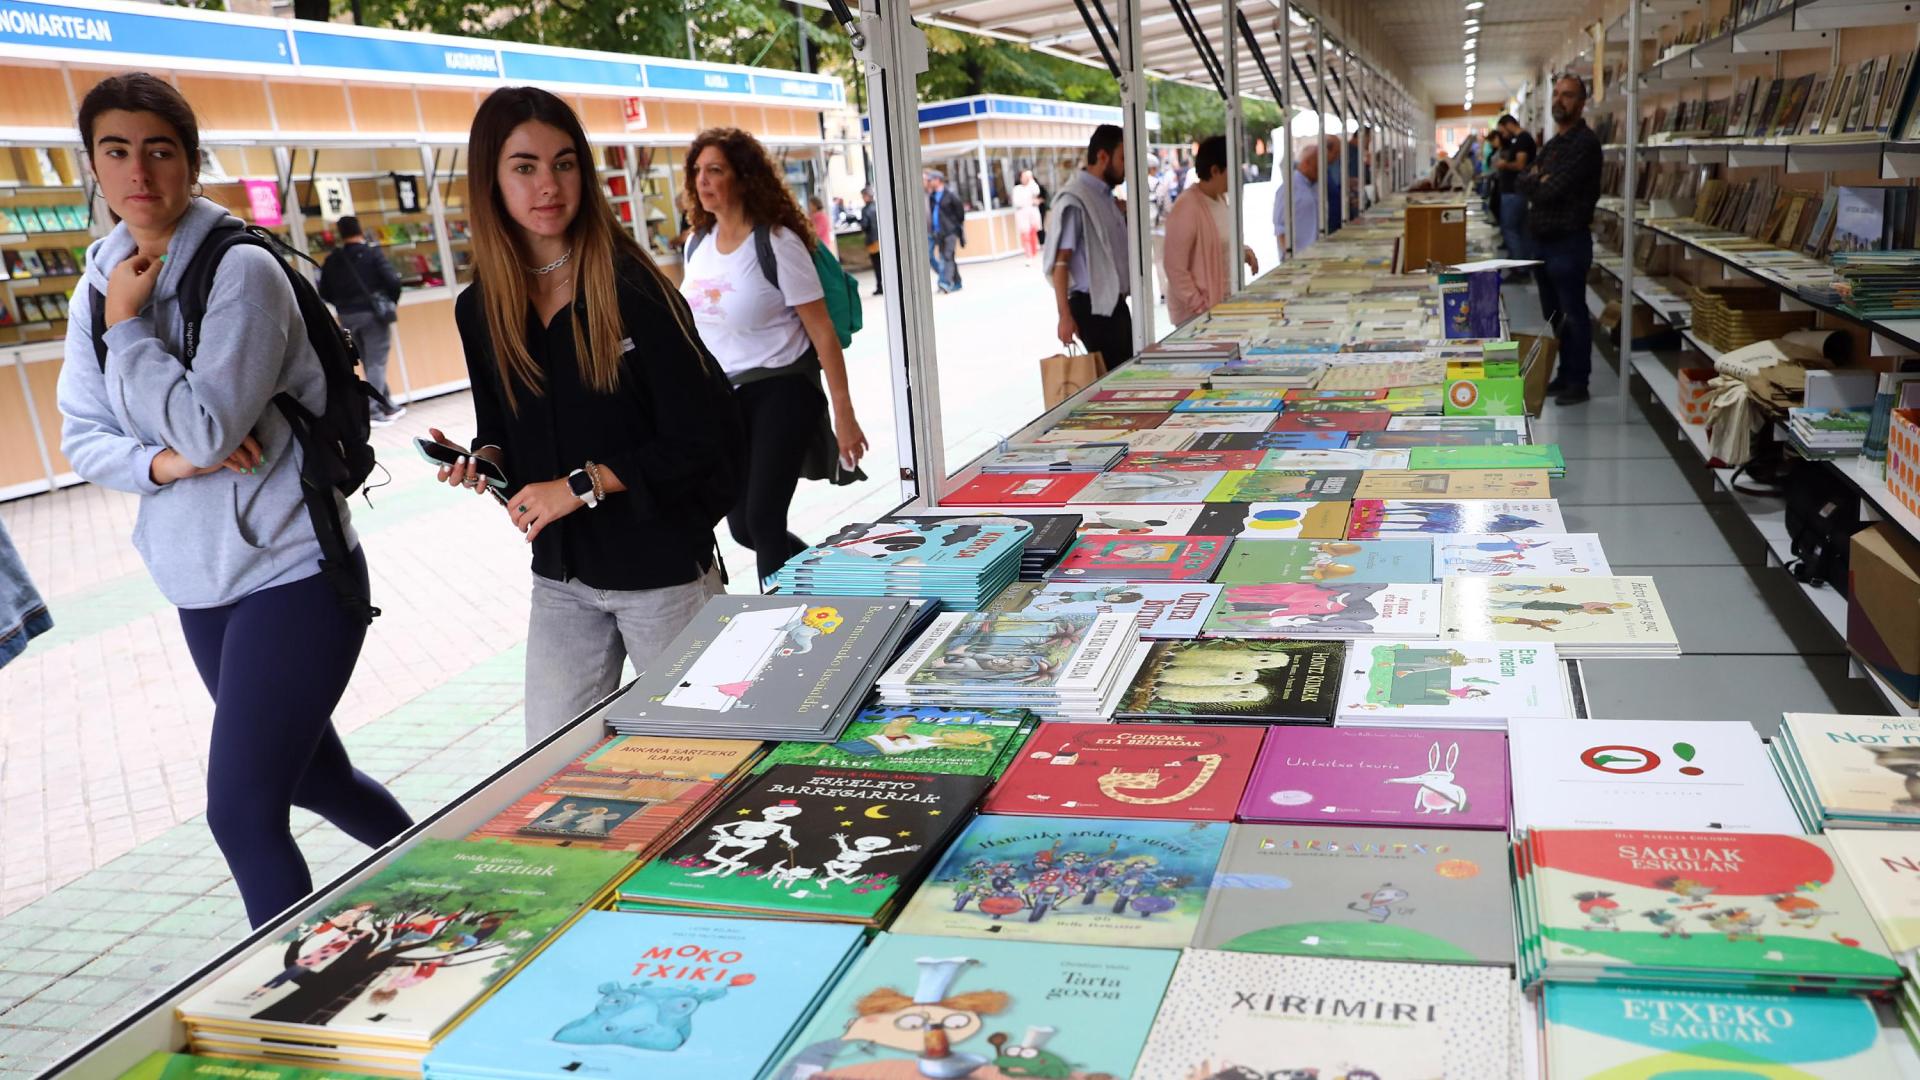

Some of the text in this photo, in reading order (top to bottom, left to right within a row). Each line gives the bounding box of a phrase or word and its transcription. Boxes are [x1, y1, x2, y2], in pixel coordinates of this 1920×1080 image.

[0, 9, 113, 42] NONARTEAN
[953, 532, 1005, 558] KIRATSA
[1167, 592, 1210, 620] OLIVER
[665, 640, 707, 677] Jill Murphy
[797, 606, 883, 713] Bost minutuko lasaialdia
[1519, 649, 1537, 664] Etxe
[1301, 652, 1330, 702] HONTZ KUMEAK
[1117, 733, 1186, 741] GOIKOAK
[1127, 739, 1203, 748] BEHEKOAK
[1826, 732, 1891, 744] Nor
[619, 746, 737, 757] ARKARA SARTZEKO
[818, 759, 871, 767] ESKER
[806, 776, 916, 790] ESKELETO
[767, 784, 941, 804] BARREGARRIAK
[1067, 830, 1135, 841] andere
[1618, 845, 1744, 863] SAGUAK
[469, 863, 558, 876] guztiak
[1631, 859, 1740, 872] ESKOLAN
[641, 944, 743, 963] MOKO
[632, 963, 729, 981] TXIKI
[1062, 972, 1121, 987] Tarta
[1046, 988, 1121, 1000] goxoa
[1231, 991, 1436, 1023] XIRIMIRI
[1622, 998, 1795, 1029] ETXEKO
[1649, 1020, 1775, 1044] SAGUAK
